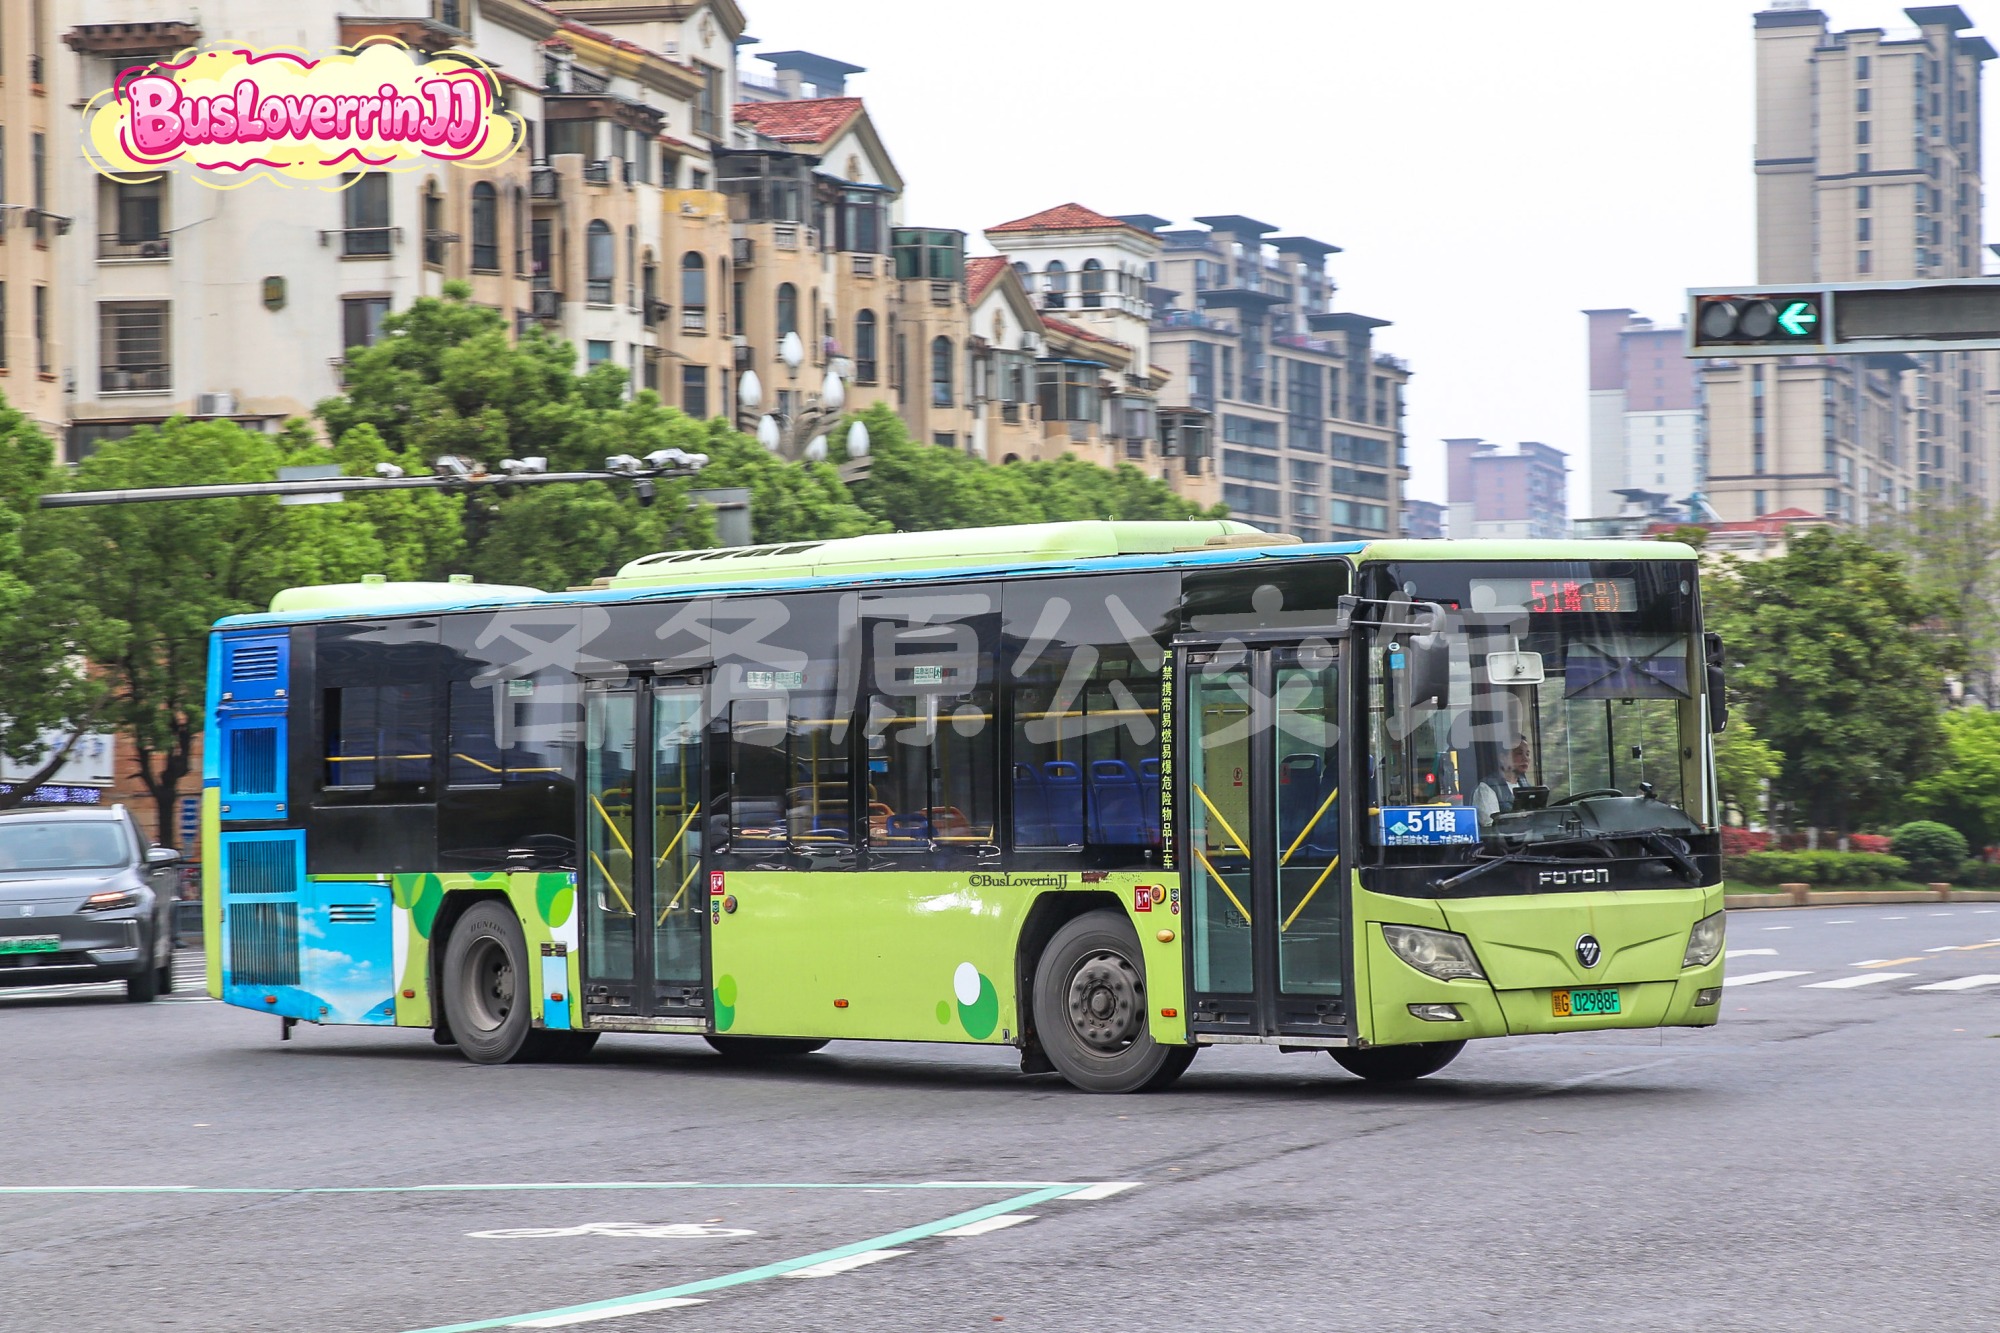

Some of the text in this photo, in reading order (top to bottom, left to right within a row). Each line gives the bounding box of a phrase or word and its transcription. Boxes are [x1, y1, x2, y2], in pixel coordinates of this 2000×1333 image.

[1161, 650, 1174, 869] 严禁携带易燃易爆危险物品上车
[1408, 810, 1456, 833] 51路
[1539, 868, 1610, 886] FOTON
[1573, 991, 1618, 1012] 02988F
